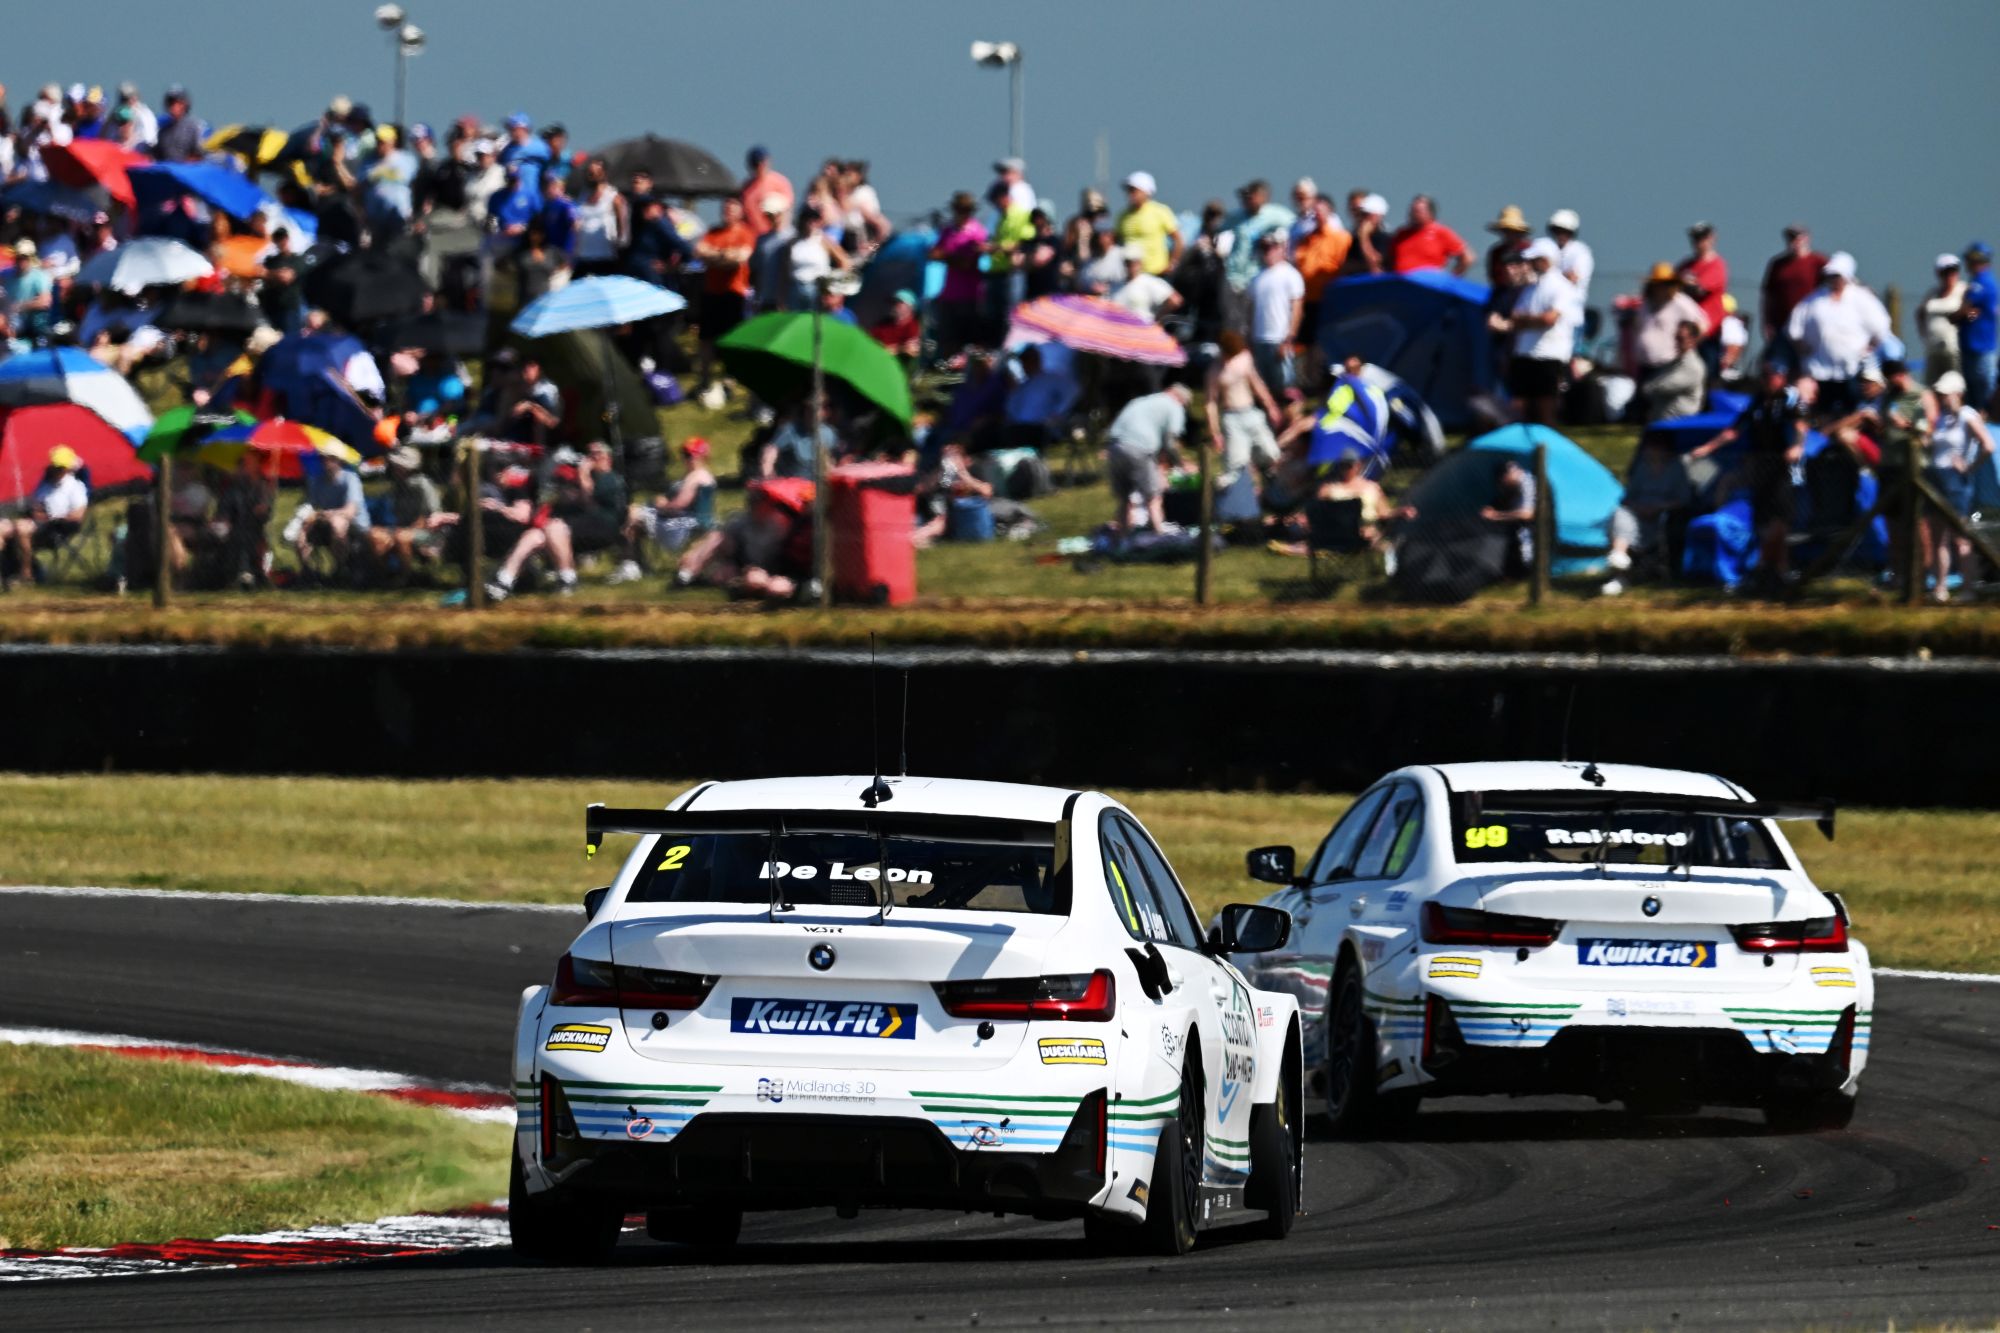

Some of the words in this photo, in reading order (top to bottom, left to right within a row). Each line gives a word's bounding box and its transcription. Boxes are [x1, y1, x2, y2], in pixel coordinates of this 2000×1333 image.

[657, 845, 691, 871] 2
[758, 861, 818, 880] De
[829, 862, 933, 884] Leon
[549, 1032, 608, 1045] DUCKHAMS
[1040, 1045, 1105, 1058] DUCKHAMS
[786, 1080, 851, 1093] Midlands
[856, 1081, 876, 1094] 3D
